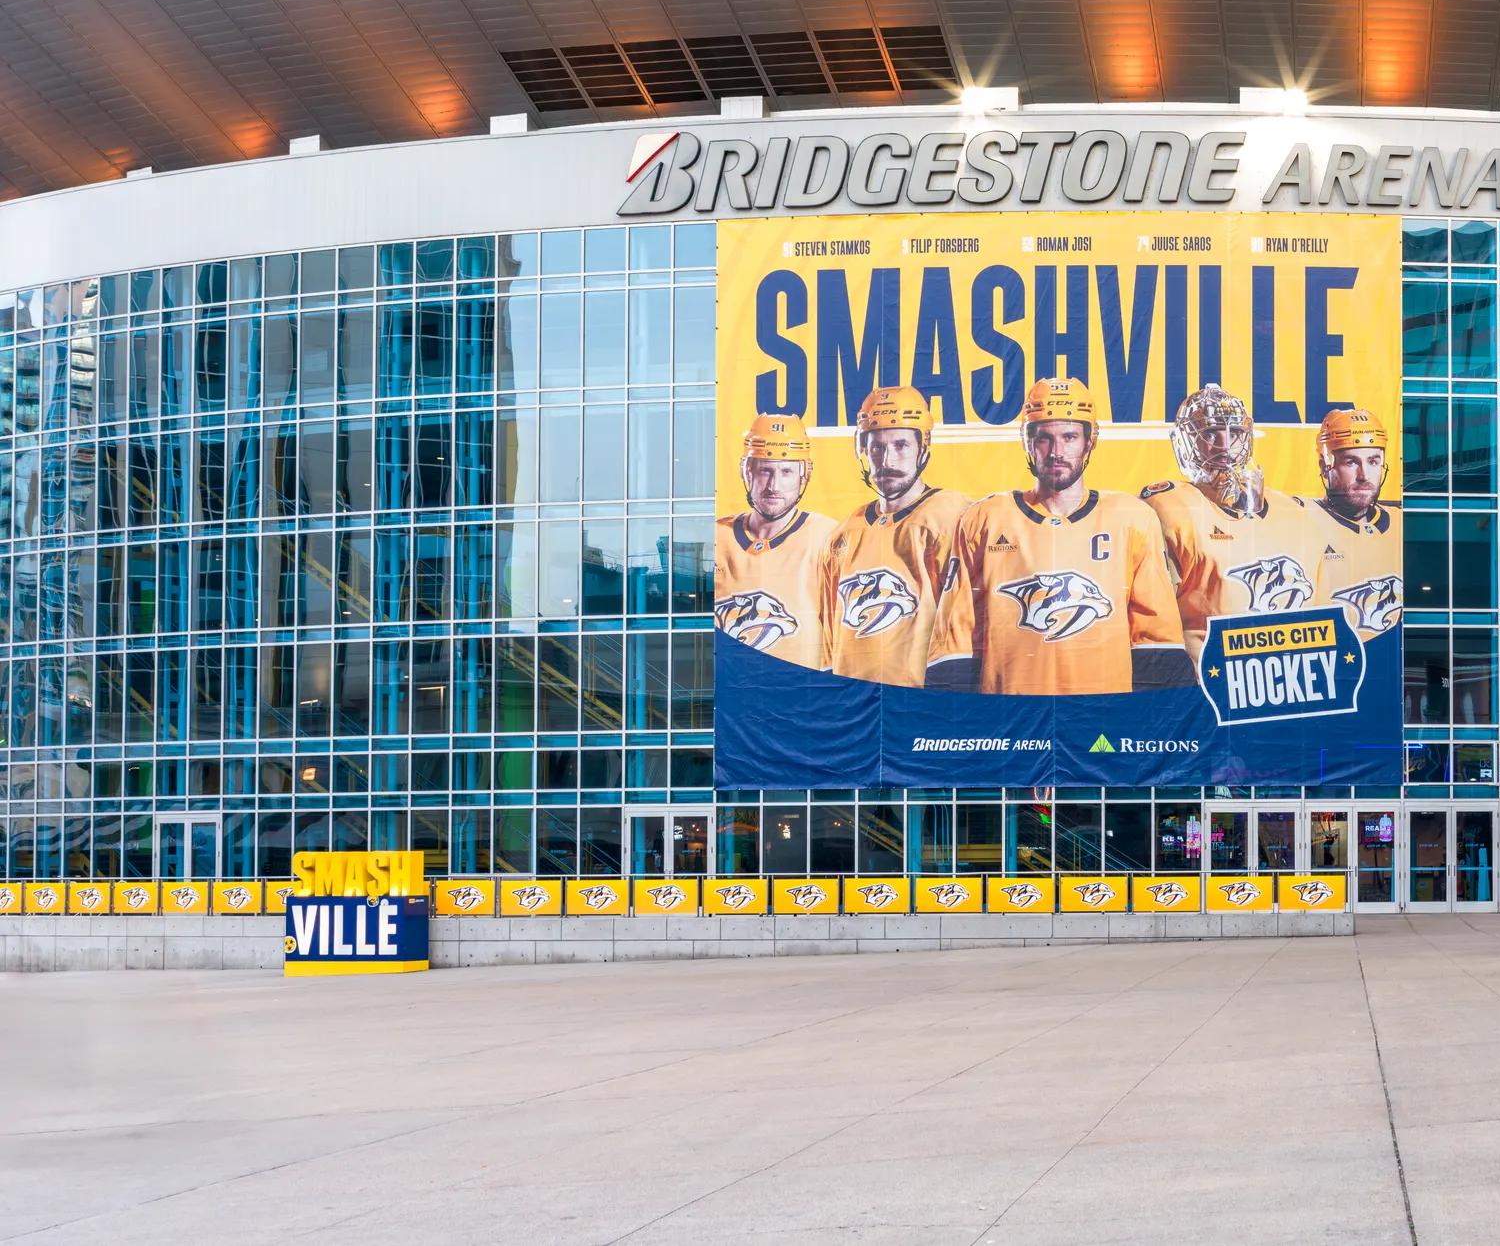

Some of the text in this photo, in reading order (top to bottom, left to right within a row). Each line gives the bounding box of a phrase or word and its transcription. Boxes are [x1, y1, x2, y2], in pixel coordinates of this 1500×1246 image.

[616, 130, 1246, 216] BRIDGESTONE
[795, 241, 827, 256] STEVEN
[830, 240, 870, 255] STAMKOS
[910, 238, 932, 253] FILIP
[935, 238, 979, 253] FORSBERG
[1037, 236, 1069, 252] ROMAN
[1072, 236, 1092, 252] JOSI
[1152, 236, 1180, 251] JUUSE
[1183, 236, 1212, 251] SAROS
[1266, 237, 1288, 253] RYAN
[1291, 237, 1329, 253] O'REILLY
[755, 265, 1359, 426] SMASHVILLE
[771, 423, 785, 433] 91
[988, 545, 1018, 553] REGIONS
[1092, 533, 1110, 561] C
[1228, 625, 1329, 651] MUSIC CITY
[1225, 650, 1337, 710] HOCKEY
[912, 737, 1051, 751] BRIDGESTONE ARENA
[1120, 738, 1199, 753] REGIONS
[292, 851, 418, 897] SMASH
[292, 905, 398, 956] VILLE
